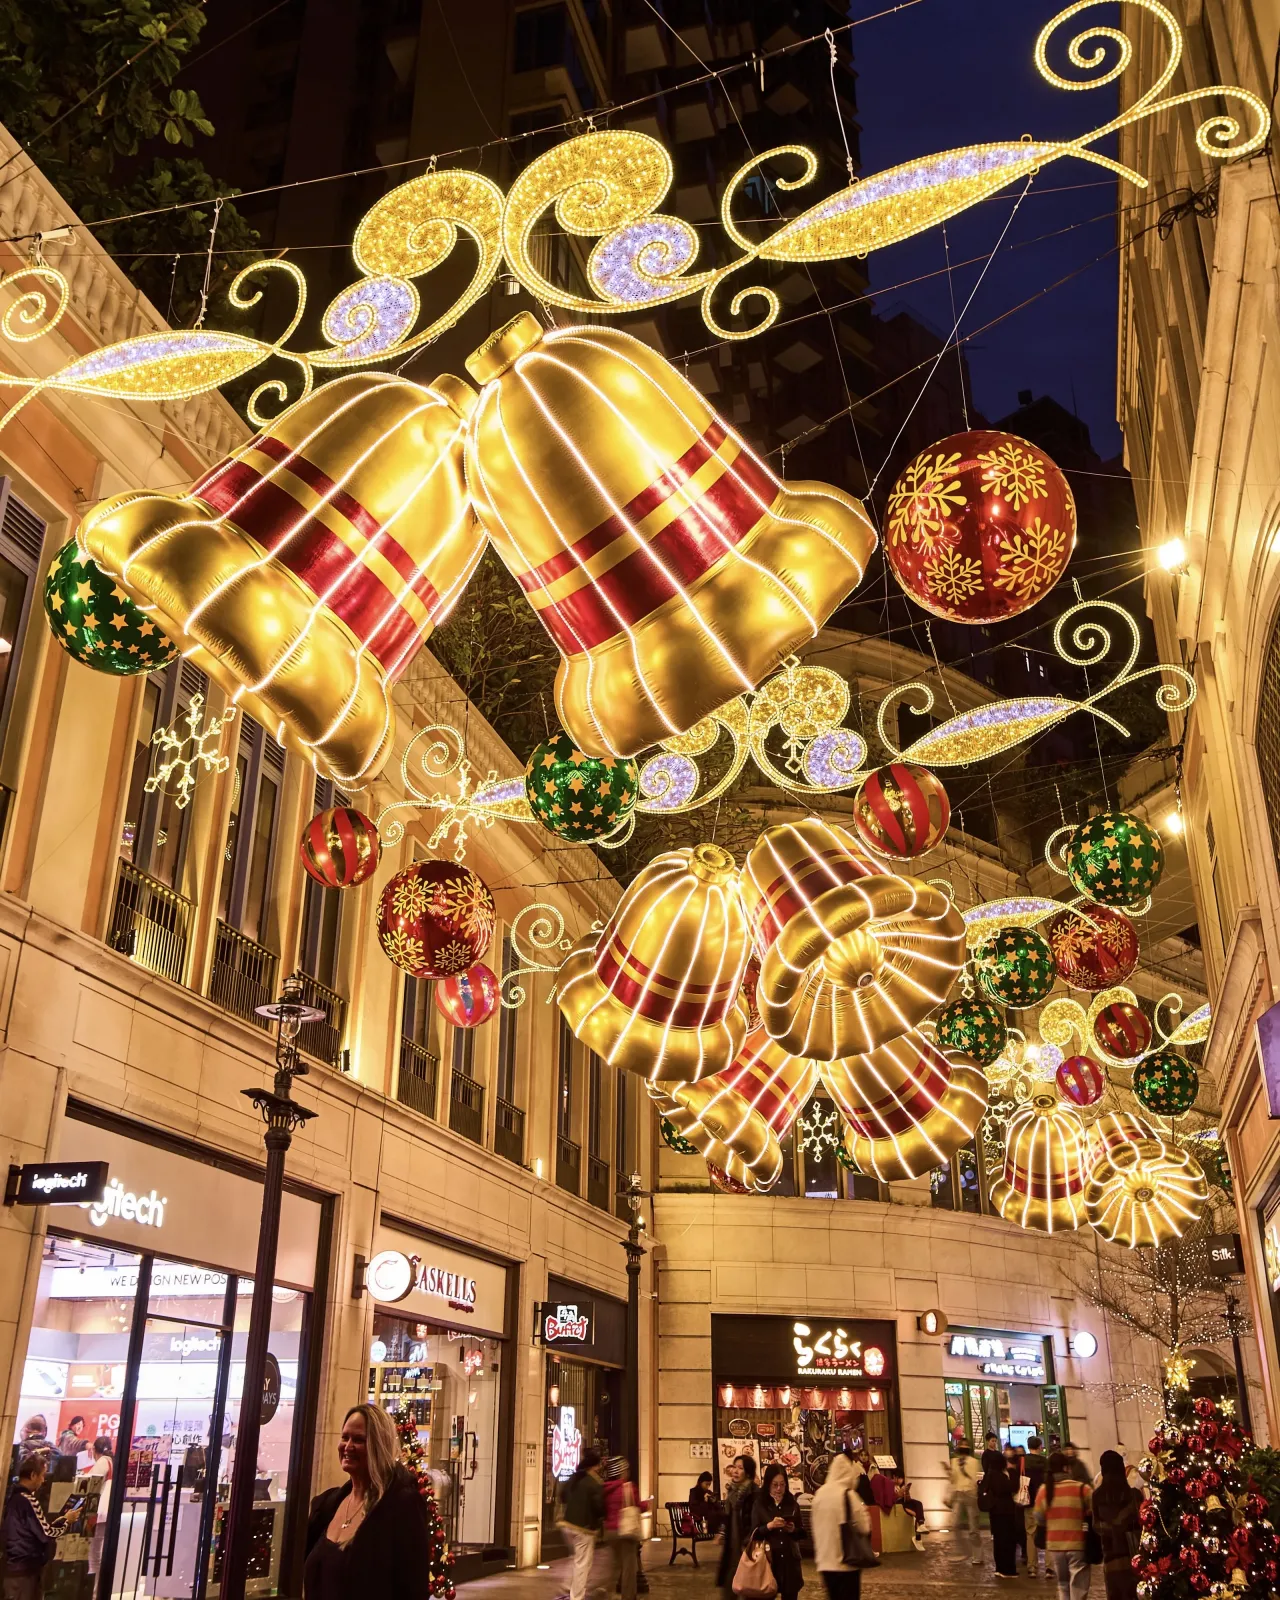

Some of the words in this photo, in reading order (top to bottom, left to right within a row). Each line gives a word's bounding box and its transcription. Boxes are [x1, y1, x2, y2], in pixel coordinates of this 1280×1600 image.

[32, 1172, 88, 1193] logitech
[80, 1178, 167, 1227] gitech
[110, 1275, 127, 1287] WE
[130, 1274, 171, 1287] DGN
[174, 1273, 202, 1286] NEW
[793, 1322, 862, 1367] らくらく
